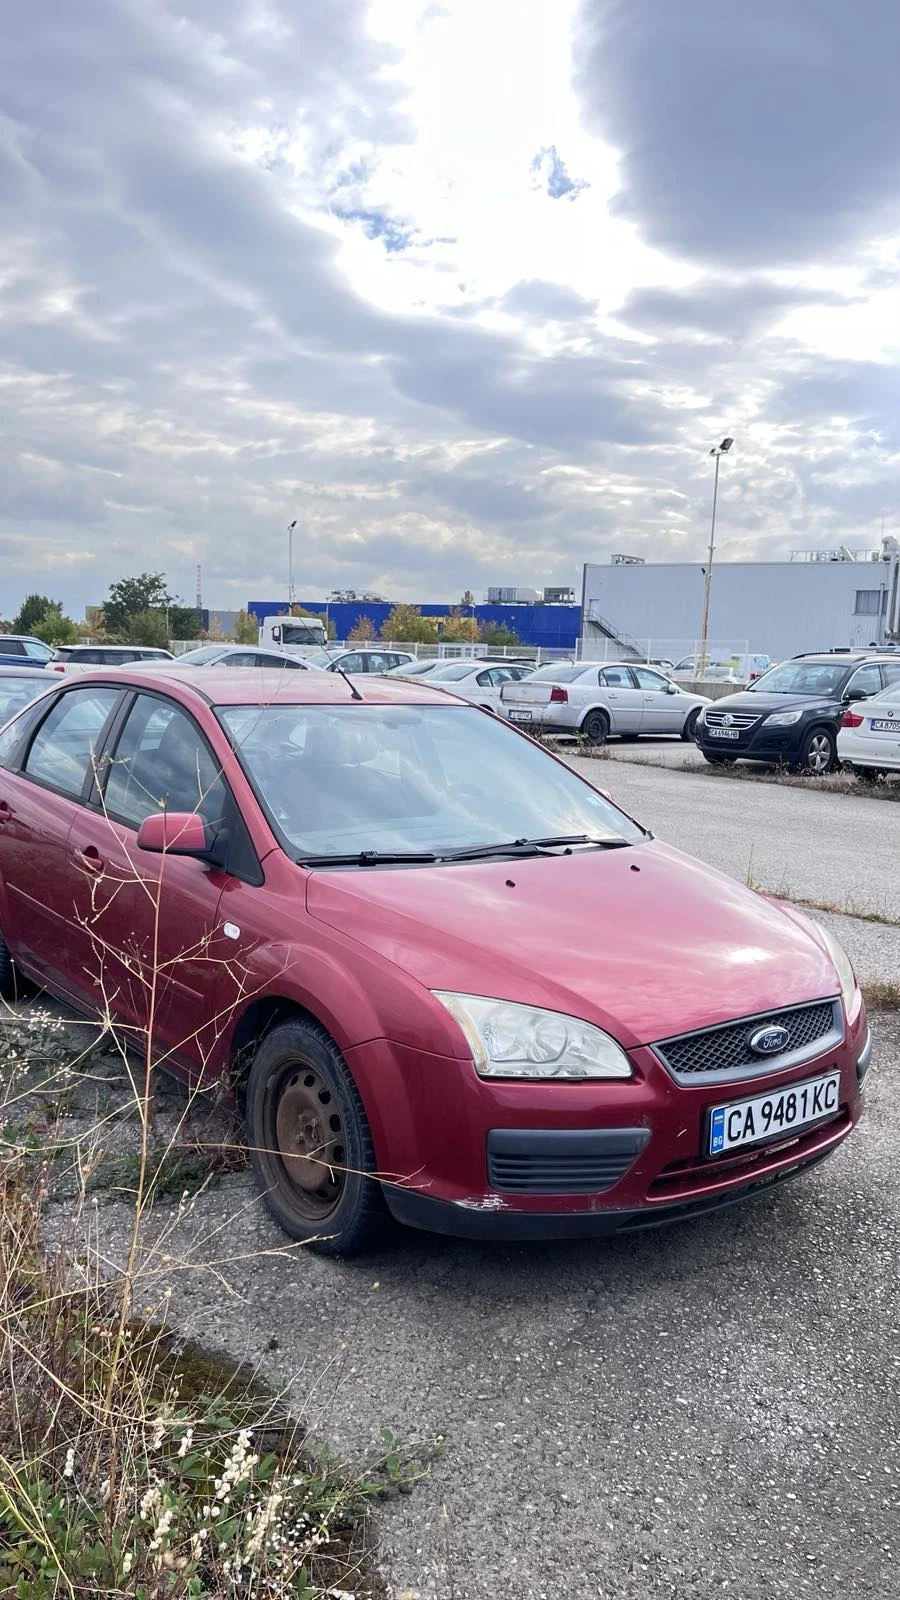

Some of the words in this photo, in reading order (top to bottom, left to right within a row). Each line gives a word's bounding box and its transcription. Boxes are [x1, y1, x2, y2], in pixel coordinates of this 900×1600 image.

[875, 721, 883, 729] CA
[763, 1033, 783, 1048] Ford
[727, 1106, 755, 1142] CA
[761, 1088, 808, 1132] 9481
[812, 1079, 837, 1115] KC
[713, 1136, 723, 1147] BG
